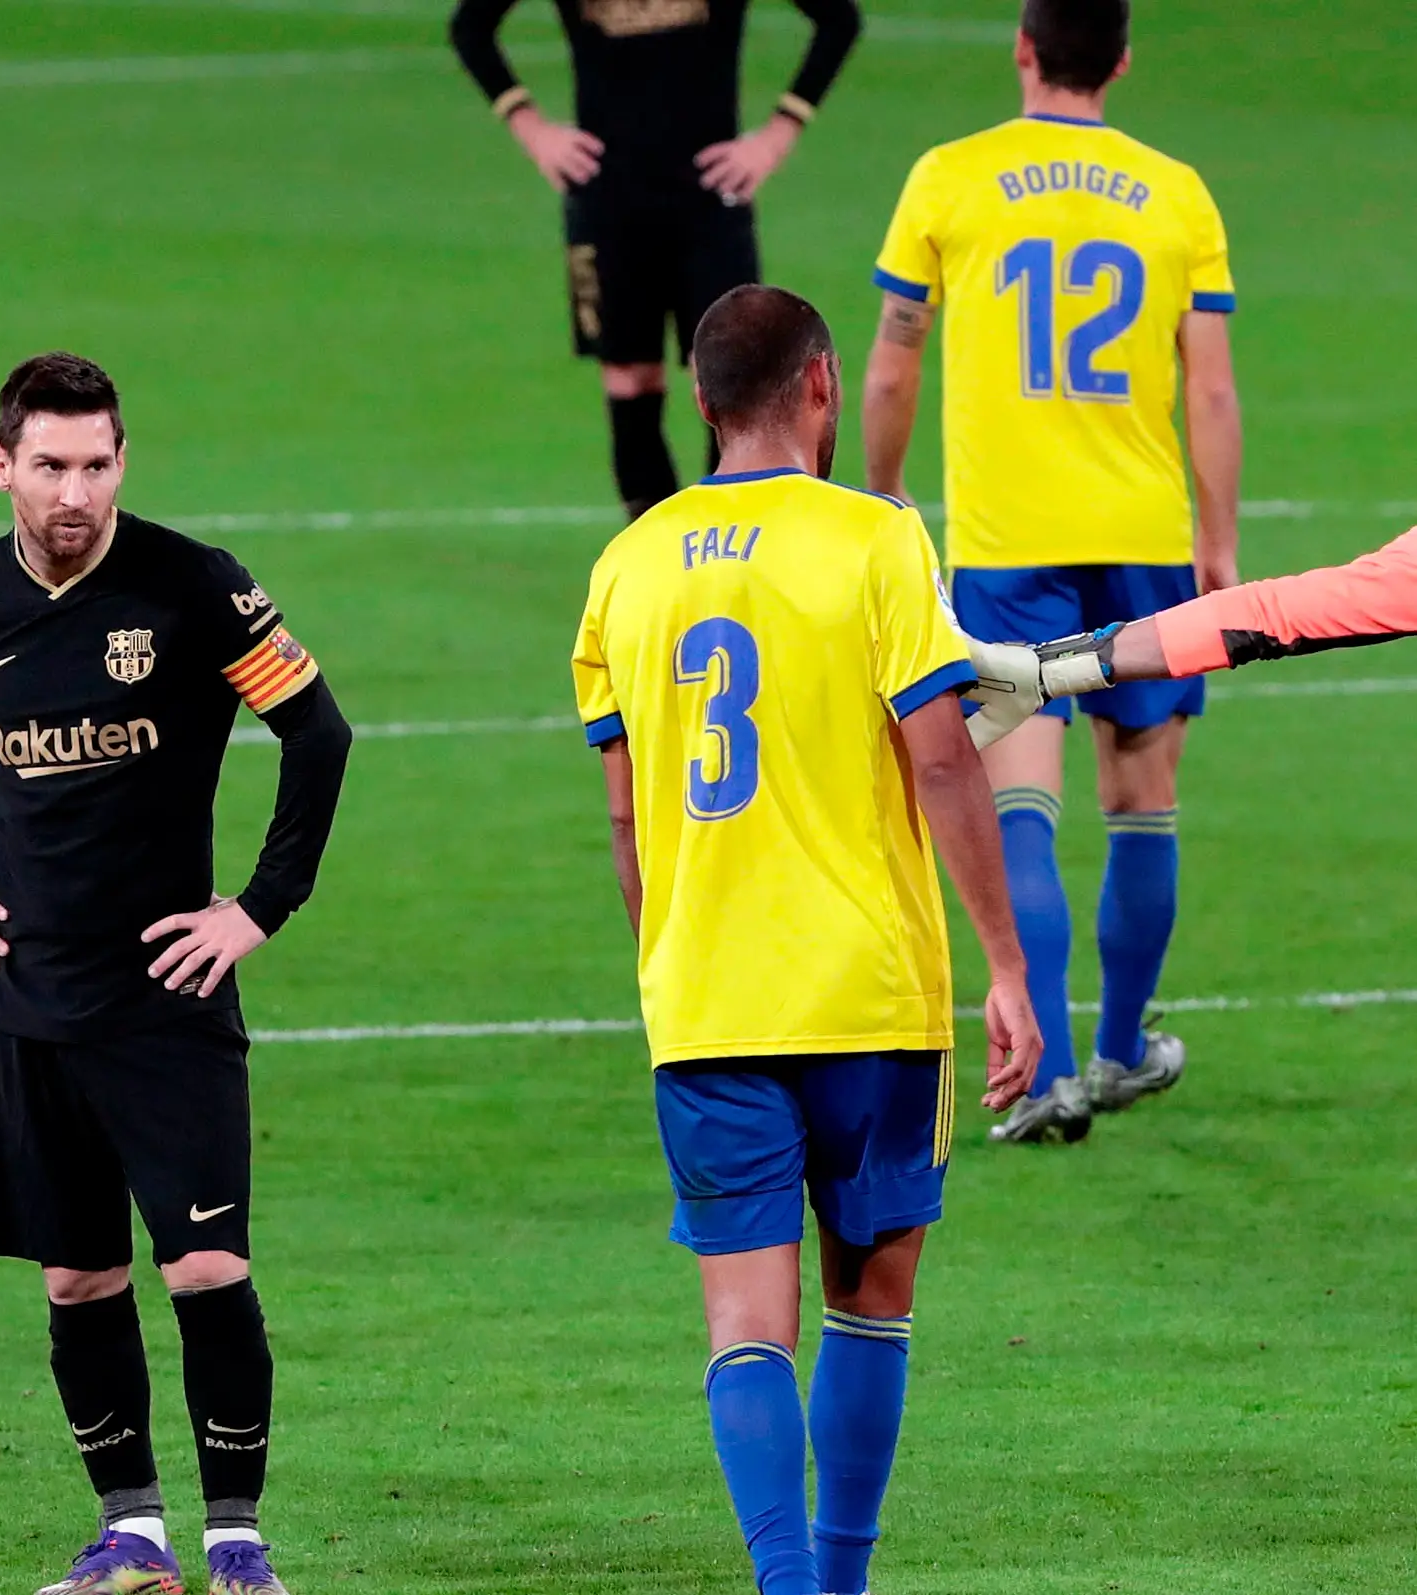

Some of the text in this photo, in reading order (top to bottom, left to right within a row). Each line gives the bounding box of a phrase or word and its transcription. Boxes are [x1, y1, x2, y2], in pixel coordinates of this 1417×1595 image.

[997, 161, 1150, 212] BODIGER
[994, 238, 1146, 404] 12
[682, 525, 762, 570] FALI
[672, 617, 760, 821] 3
